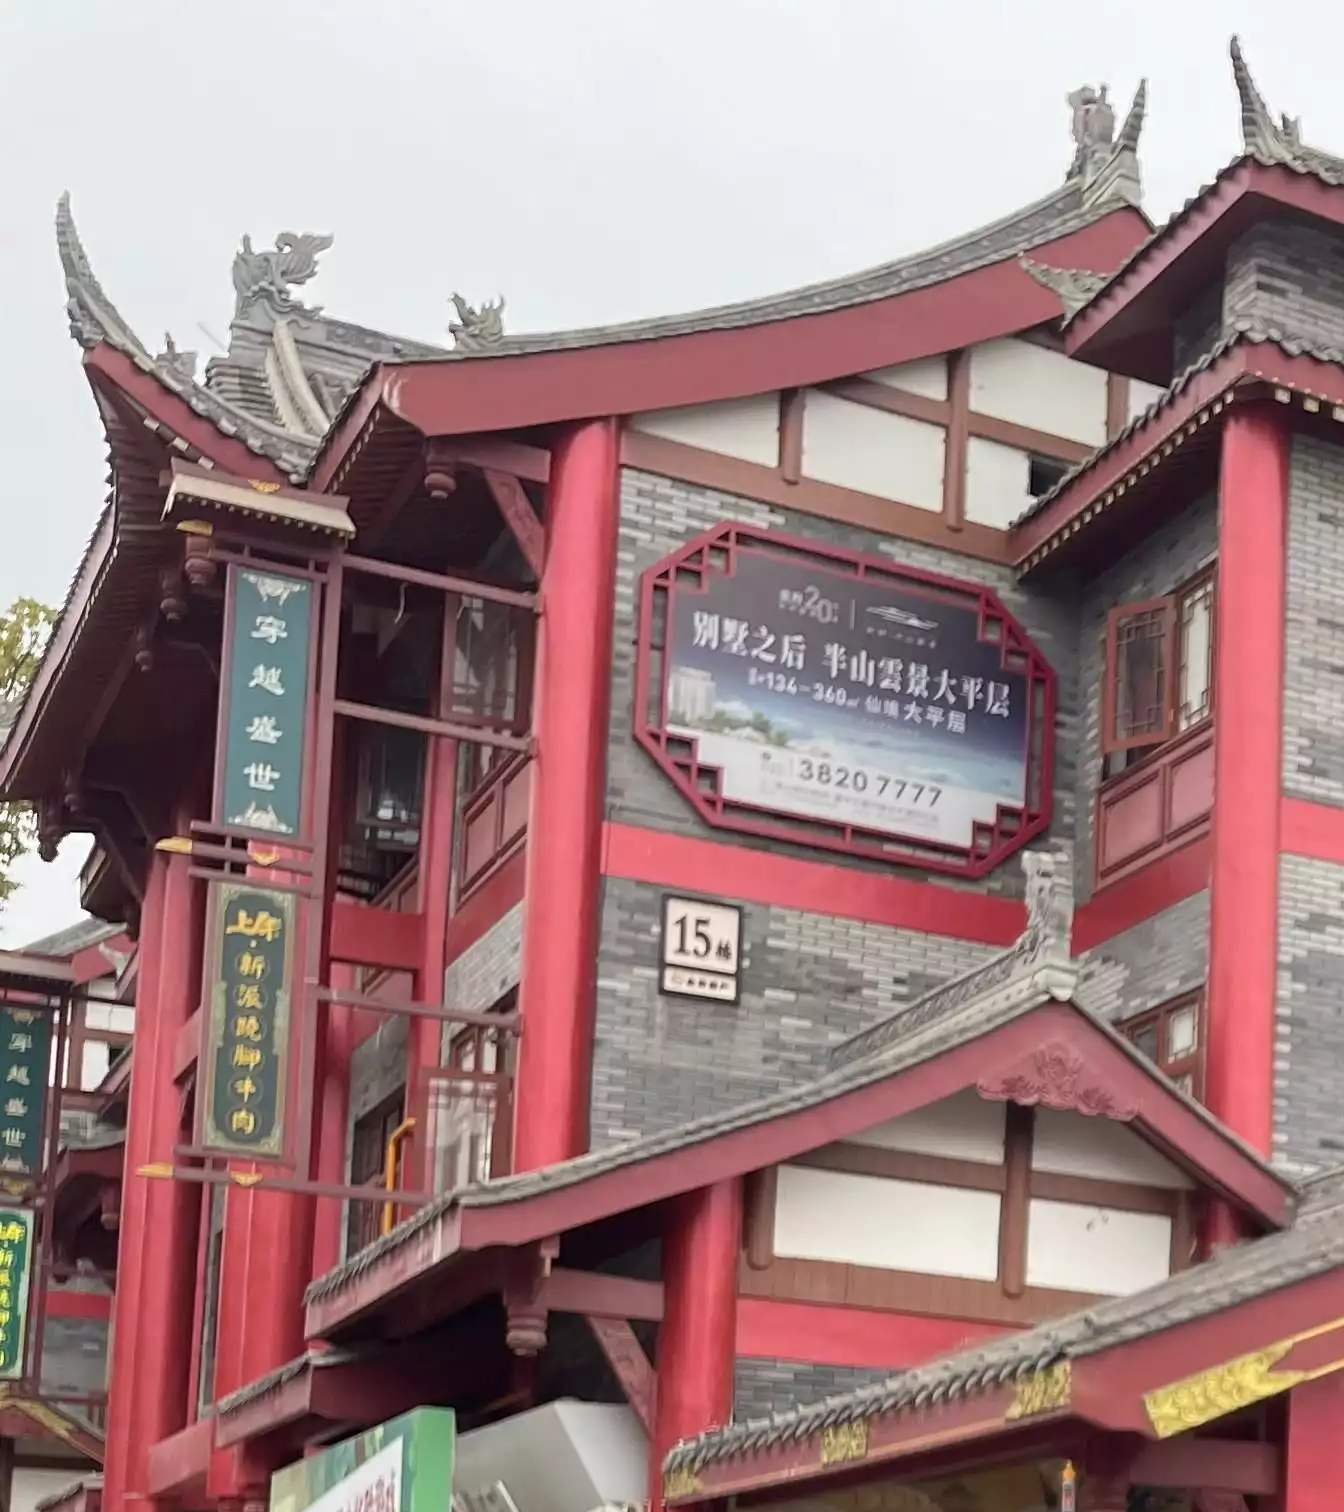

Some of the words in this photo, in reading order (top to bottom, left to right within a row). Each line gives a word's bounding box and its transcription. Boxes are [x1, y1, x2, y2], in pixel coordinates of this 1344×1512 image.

[243, 614, 288, 791] 穿越盛世
[692, 610, 806, 671] 别墅之后
[821, 641, 1011, 719] 半山雲景大平层
[799, 758, 868, 793] 3820
[875, 774, 943, 808] 7777
